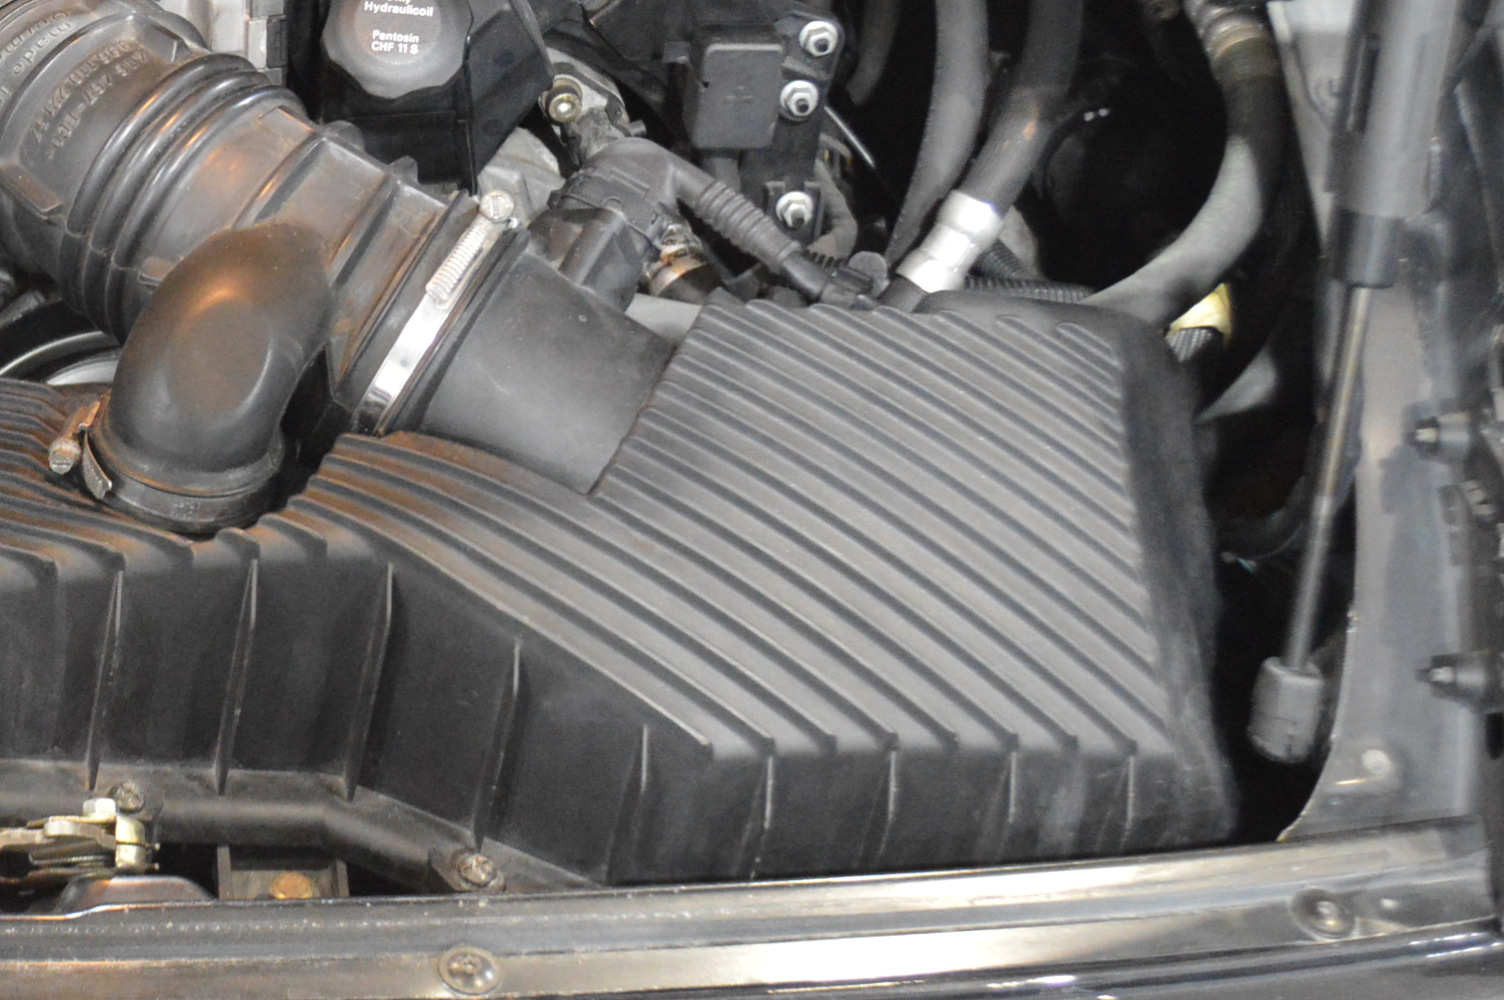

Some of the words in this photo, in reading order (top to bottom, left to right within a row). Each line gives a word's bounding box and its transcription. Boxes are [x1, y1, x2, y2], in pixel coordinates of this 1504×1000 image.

[364, 0, 434, 16] Hydraulicoil
[372, 29, 419, 43] Pentosin
[13, 21, 71, 75] made
[371, 40, 395, 52] CHF
[398, 42, 408, 54] 11
